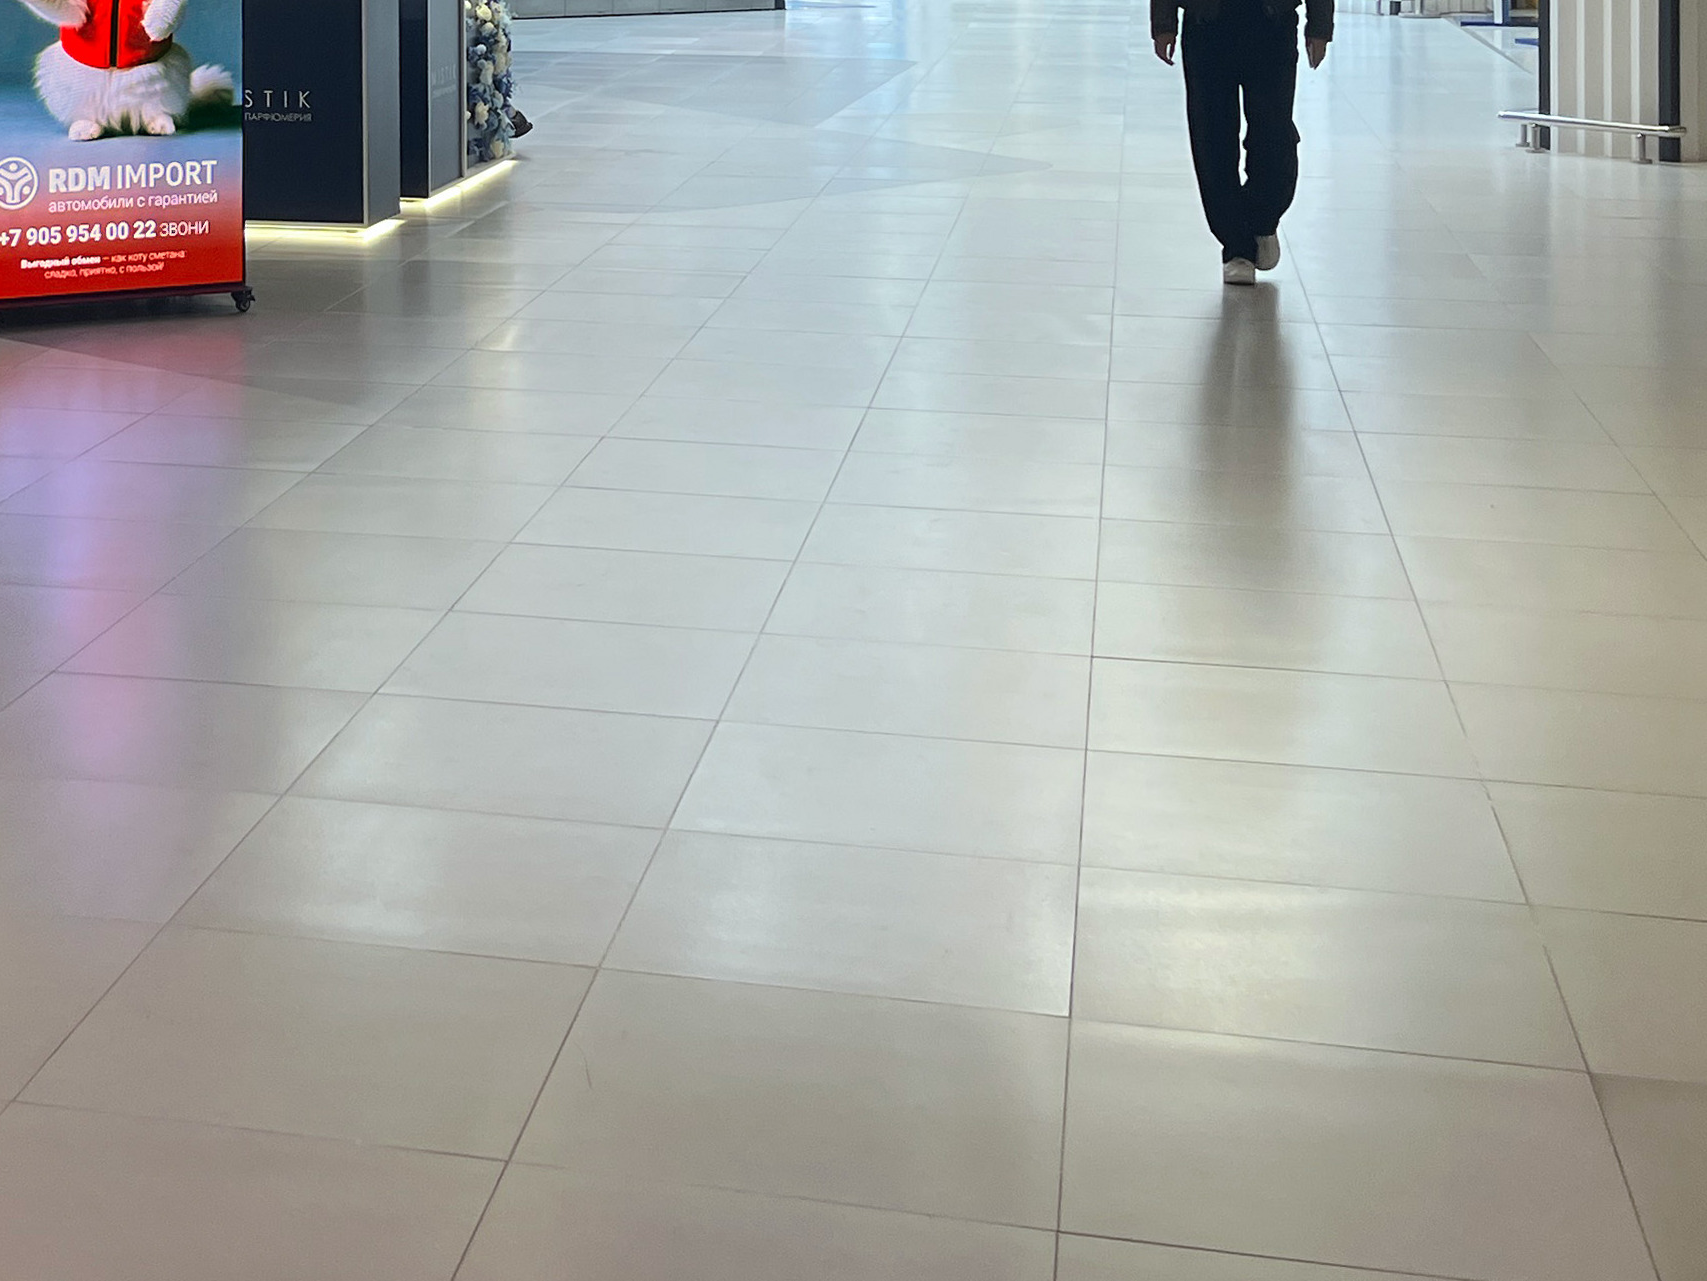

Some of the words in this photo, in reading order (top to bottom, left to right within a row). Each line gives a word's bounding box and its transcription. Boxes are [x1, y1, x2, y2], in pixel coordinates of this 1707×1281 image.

[48, 166, 110, 193] RDM
[117, 160, 218, 189] IMPORT
[48, 195, 134, 213] автомобили
[136, 197, 146, 208] с
[148, 190, 218, 209] гарантией
[26, 226, 61, 246] 905
[66, 223, 102, 244] 954
[105, 221, 130, 241] 00
[133, 220, 157, 239] 22
[159, 220, 210, 237] ЗВОНИ
[20, 256, 70, 270] Выгодный
[71, 254, 101, 266] обмен
[111, 255, 127, 263] как
[128, 253, 148, 263] коту
